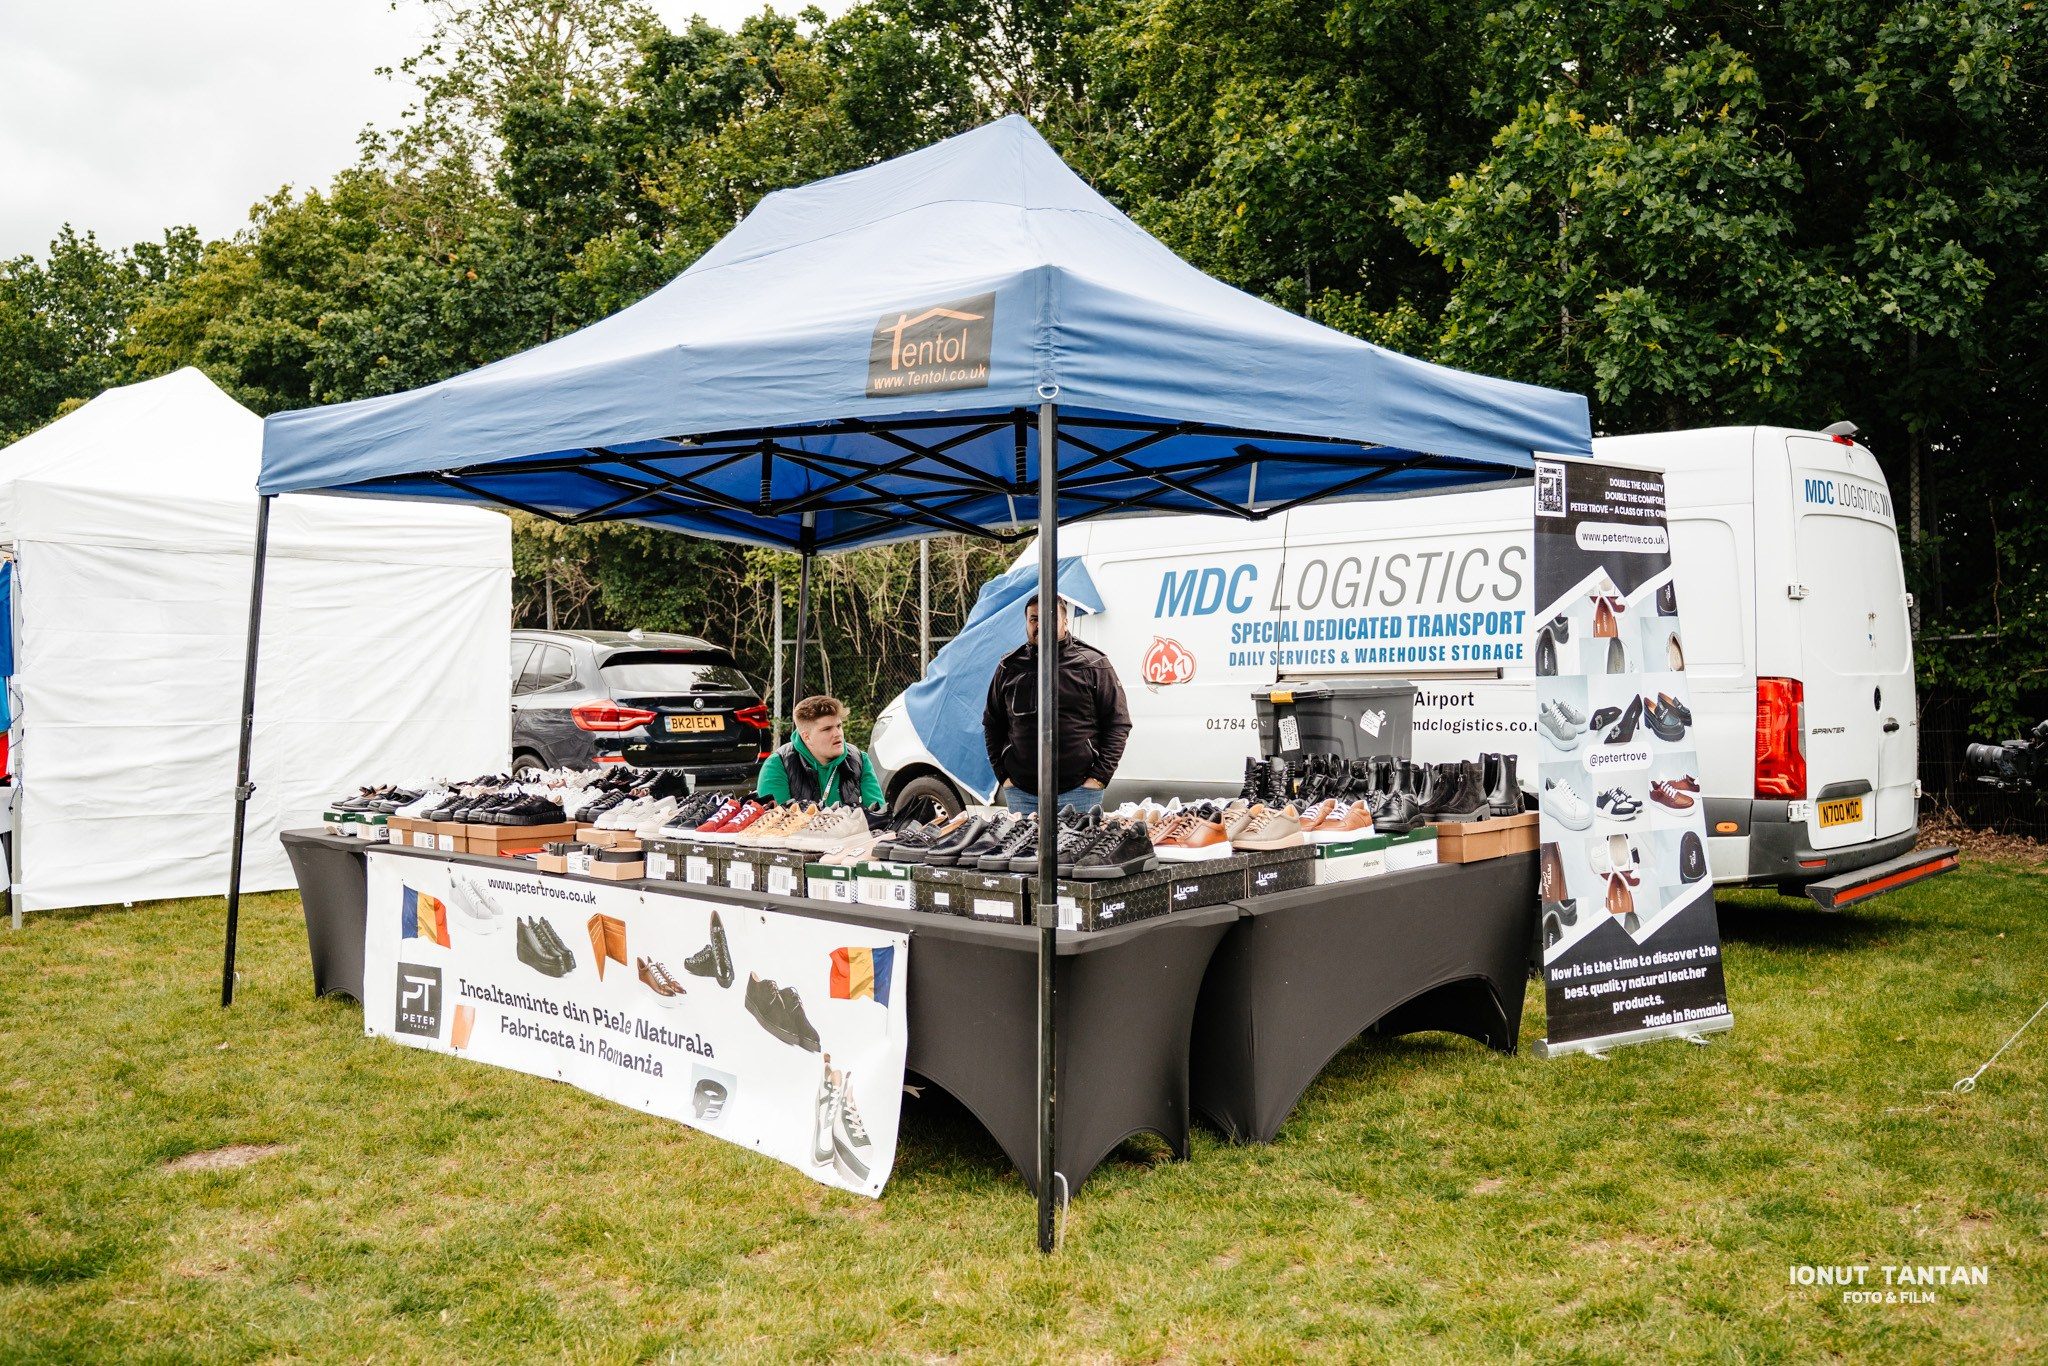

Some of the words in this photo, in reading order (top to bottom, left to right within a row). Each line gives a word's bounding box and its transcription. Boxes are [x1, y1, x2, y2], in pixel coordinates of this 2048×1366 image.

[1609, 477, 1631, 489] DOUBLE
[1630, 480, 1642, 490] THE
[1641, 482, 1664, 493] QUALITY
[1604, 491, 1627, 502] DOUBLE
[1626, 493, 1638, 503] THE
[1805, 478, 1835, 505] MDC
[1837, 482, 1881, 515] LOGISTICS
[1570, 502, 1589, 513] PETER
[1588, 504, 1609, 514] TROVE
[1619, 506, 1636, 516] CLASS
[1636, 507, 1644, 517] OF
[1581, 531, 1666, 546] www.petertrove.co.uk
[1154, 563, 1258, 618] MDC
[1269, 545, 1527, 612] LOGISTICS
[1231, 620, 1299, 645] SPECIAL
[1303, 616, 1402, 642] DEDICATED
[1406, 610, 1526, 638] TRANSPORT
[1229, 651, 1265, 667] DAILY
[1270, 648, 1336, 666] SERVICES
[1340, 650, 1350, 664] &
[1355, 645, 1446, 664] WAREHOUSE
[1451, 643, 1524, 662] STORAGE
[1414, 691, 1475, 710] Airport
[671, 718, 695, 729] BK21
[697, 717, 717, 728] ECW
[1206, 718, 1246, 730] 01784
[1811, 726, 1846, 735] SPRINTER
[1589, 752, 1647, 767] @petertrove
[1822, 803, 1845, 824] N700
[487, 878, 597, 905] www.petertrove.co.uk
[1551, 966, 1573, 981] Now
[1572, 964, 1583, 977] it
[1583, 963, 1593, 975] is
[1594, 959, 1613, 974] the
[1613, 956, 1639, 970] time
[1639, 953, 1652, 966] to
[1652, 949, 1698, 965] discover
[1698, 945, 1718, 958] the
[1564, 983, 1590, 1000] best
[1590, 978, 1628, 997] quality
[1628, 971, 1669, 989] natural
[1668, 966, 1708, 983] leather
[1612, 994, 1665, 1014] products.
[402, 1012, 435, 1026] PETER
[459, 978, 559, 1016] Incaltaminte
[562, 1000, 590, 1024] din
[592, 1007, 632, 1036] Piele
[634, 1018, 715, 1059] Naturala
[1642, 1012, 1673, 1027] -Made
[1672, 1009, 1684, 1022] in
[1684, 1002, 1728, 1020] Romania
[501, 1015, 576, 1050] Fabricata
[579, 1033, 595, 1056] in
[598, 1038, 664, 1078] Romania
